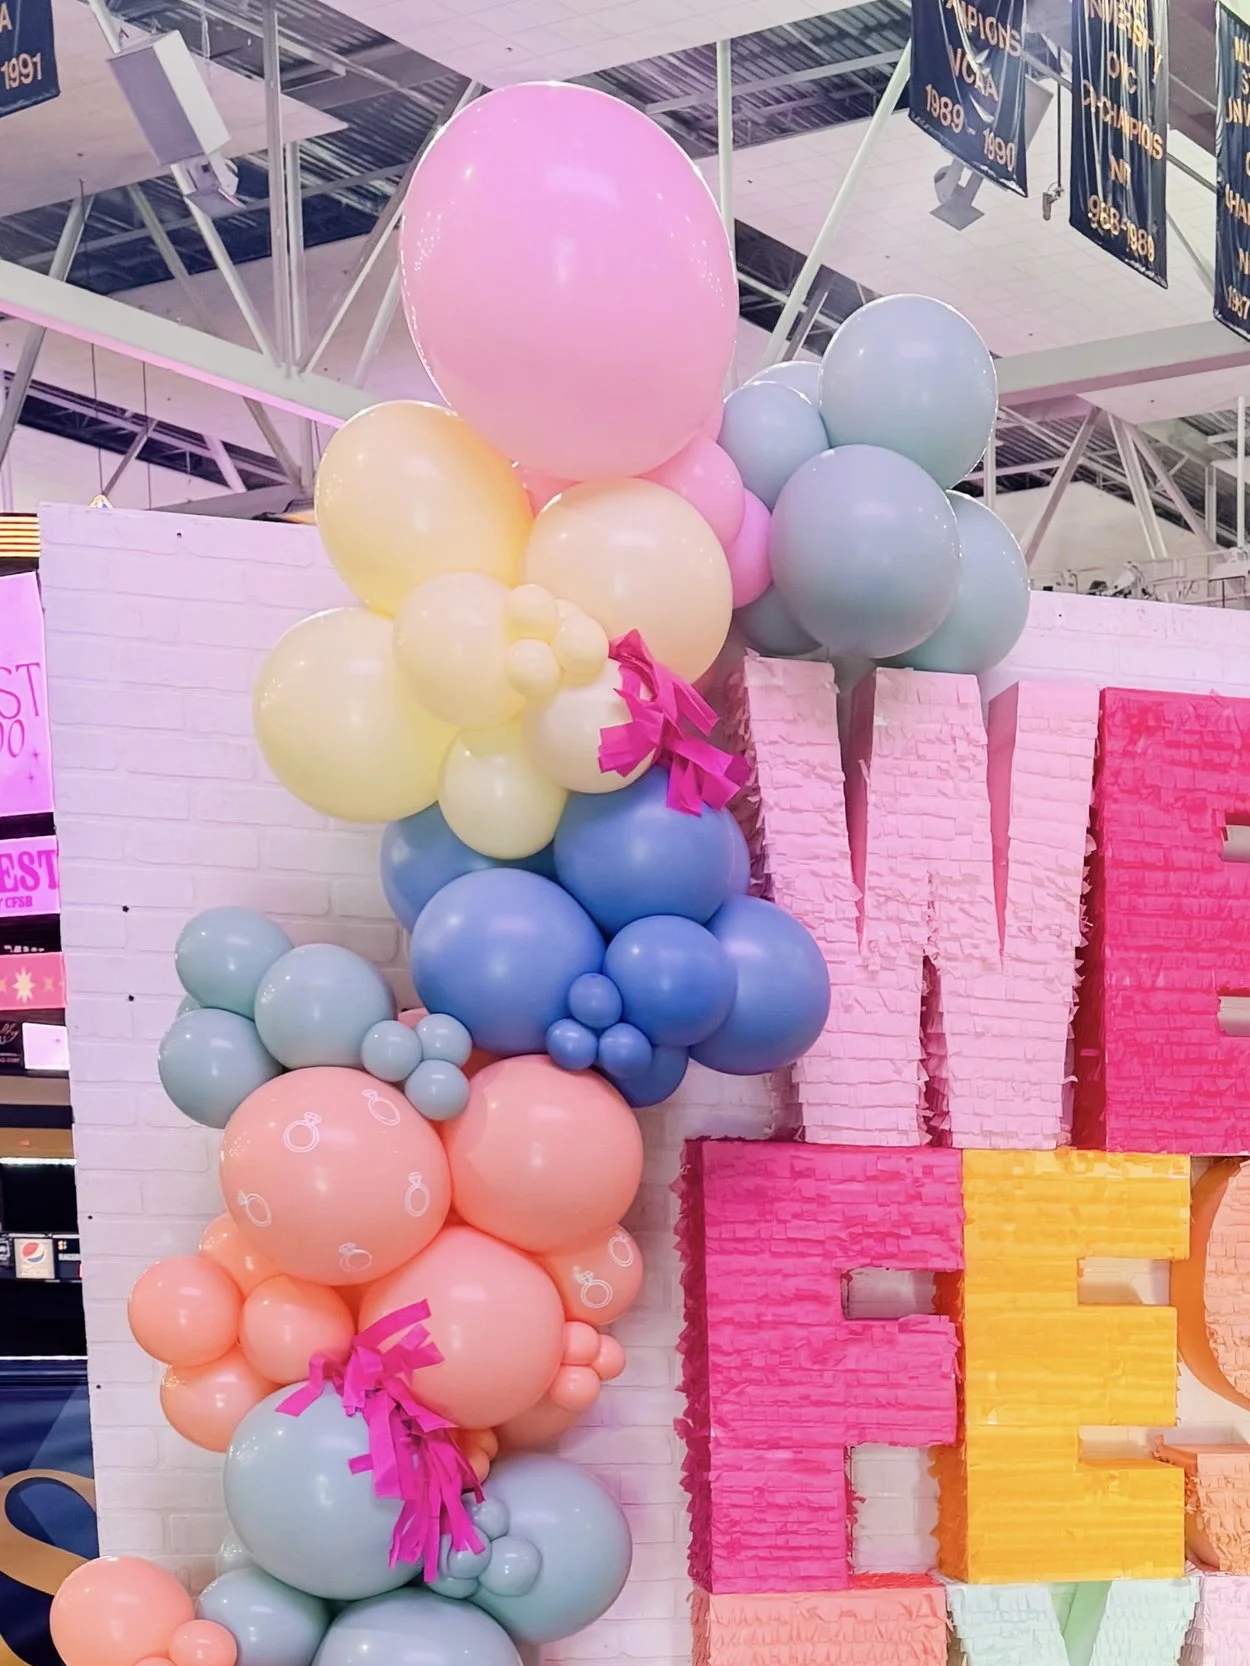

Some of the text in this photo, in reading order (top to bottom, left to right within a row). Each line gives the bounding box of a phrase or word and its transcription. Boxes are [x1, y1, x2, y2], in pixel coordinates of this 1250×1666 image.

[0, 52, 42, 90] 1991
[925, 83, 964, 134] 1989
[982, 127, 1017, 173] 1990
